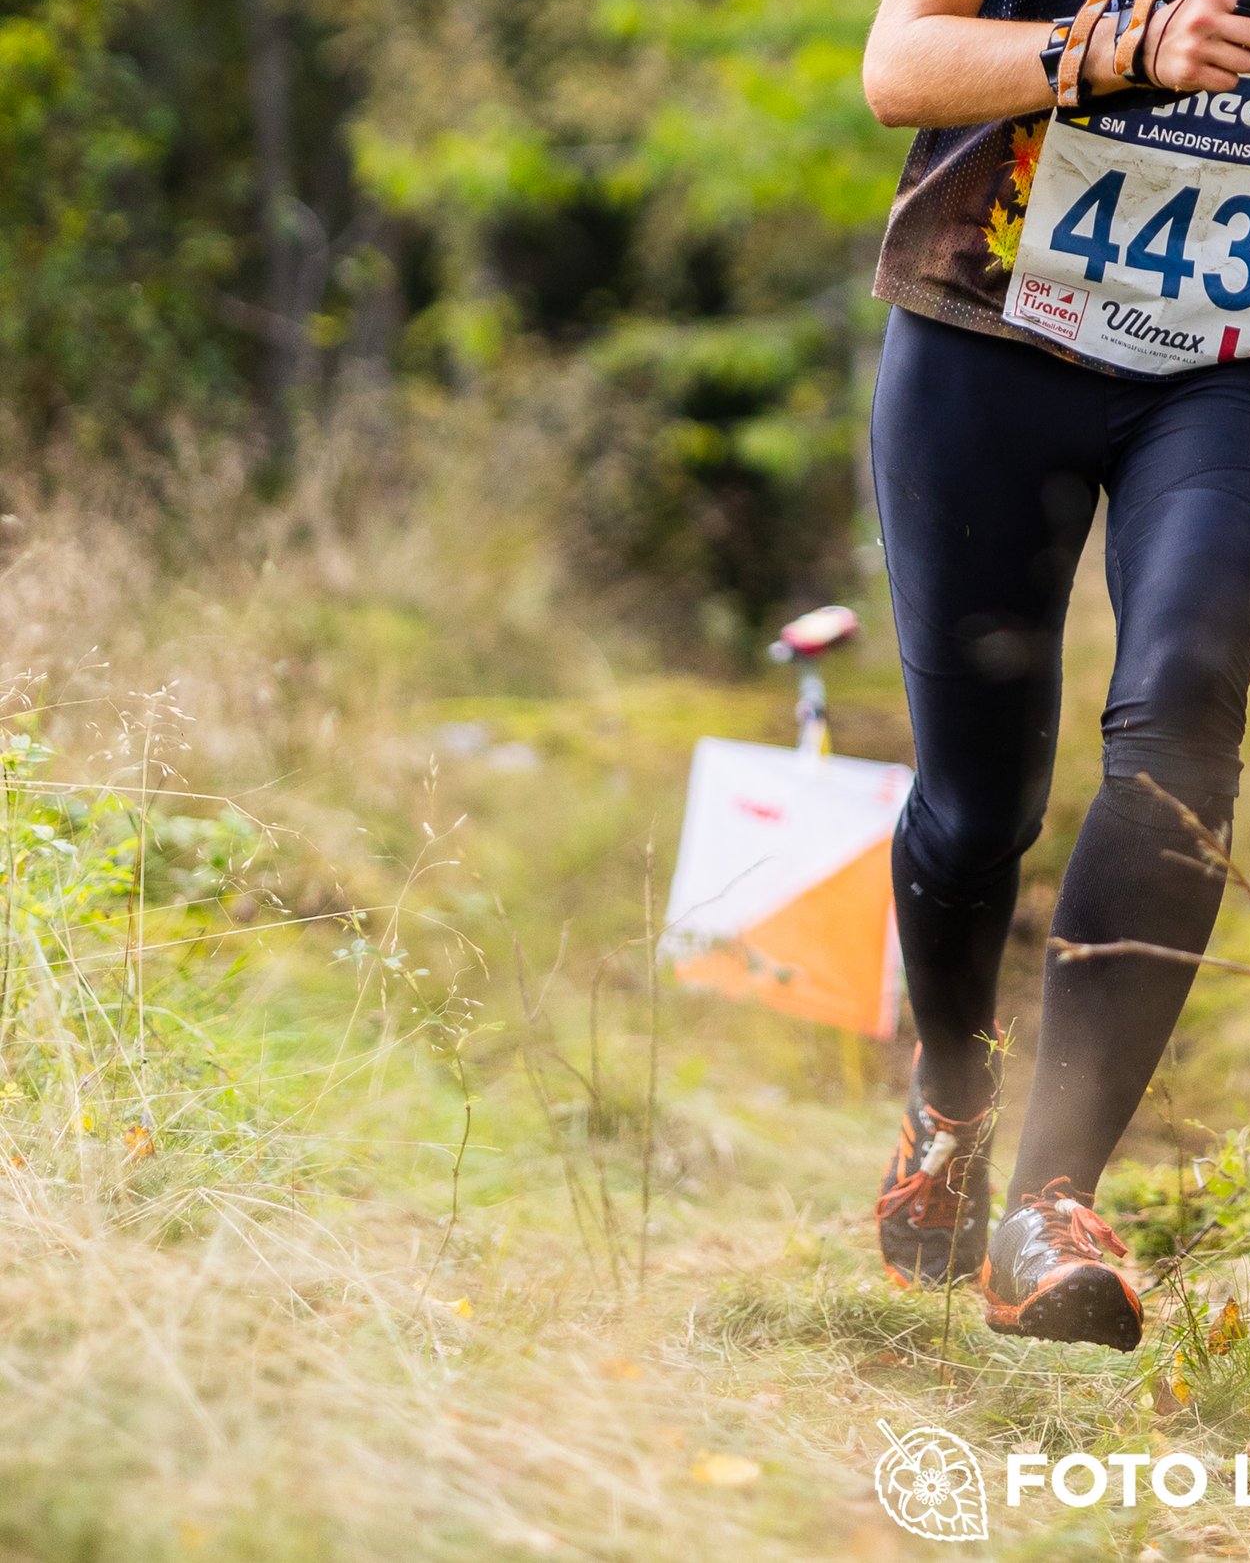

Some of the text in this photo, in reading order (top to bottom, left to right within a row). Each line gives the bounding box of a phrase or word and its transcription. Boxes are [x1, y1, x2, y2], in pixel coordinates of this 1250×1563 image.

[1100, 116, 1126, 134] SM
[1023, 292, 1079, 323] Tisaren
[1101, 300, 1205, 353] Ullmax
